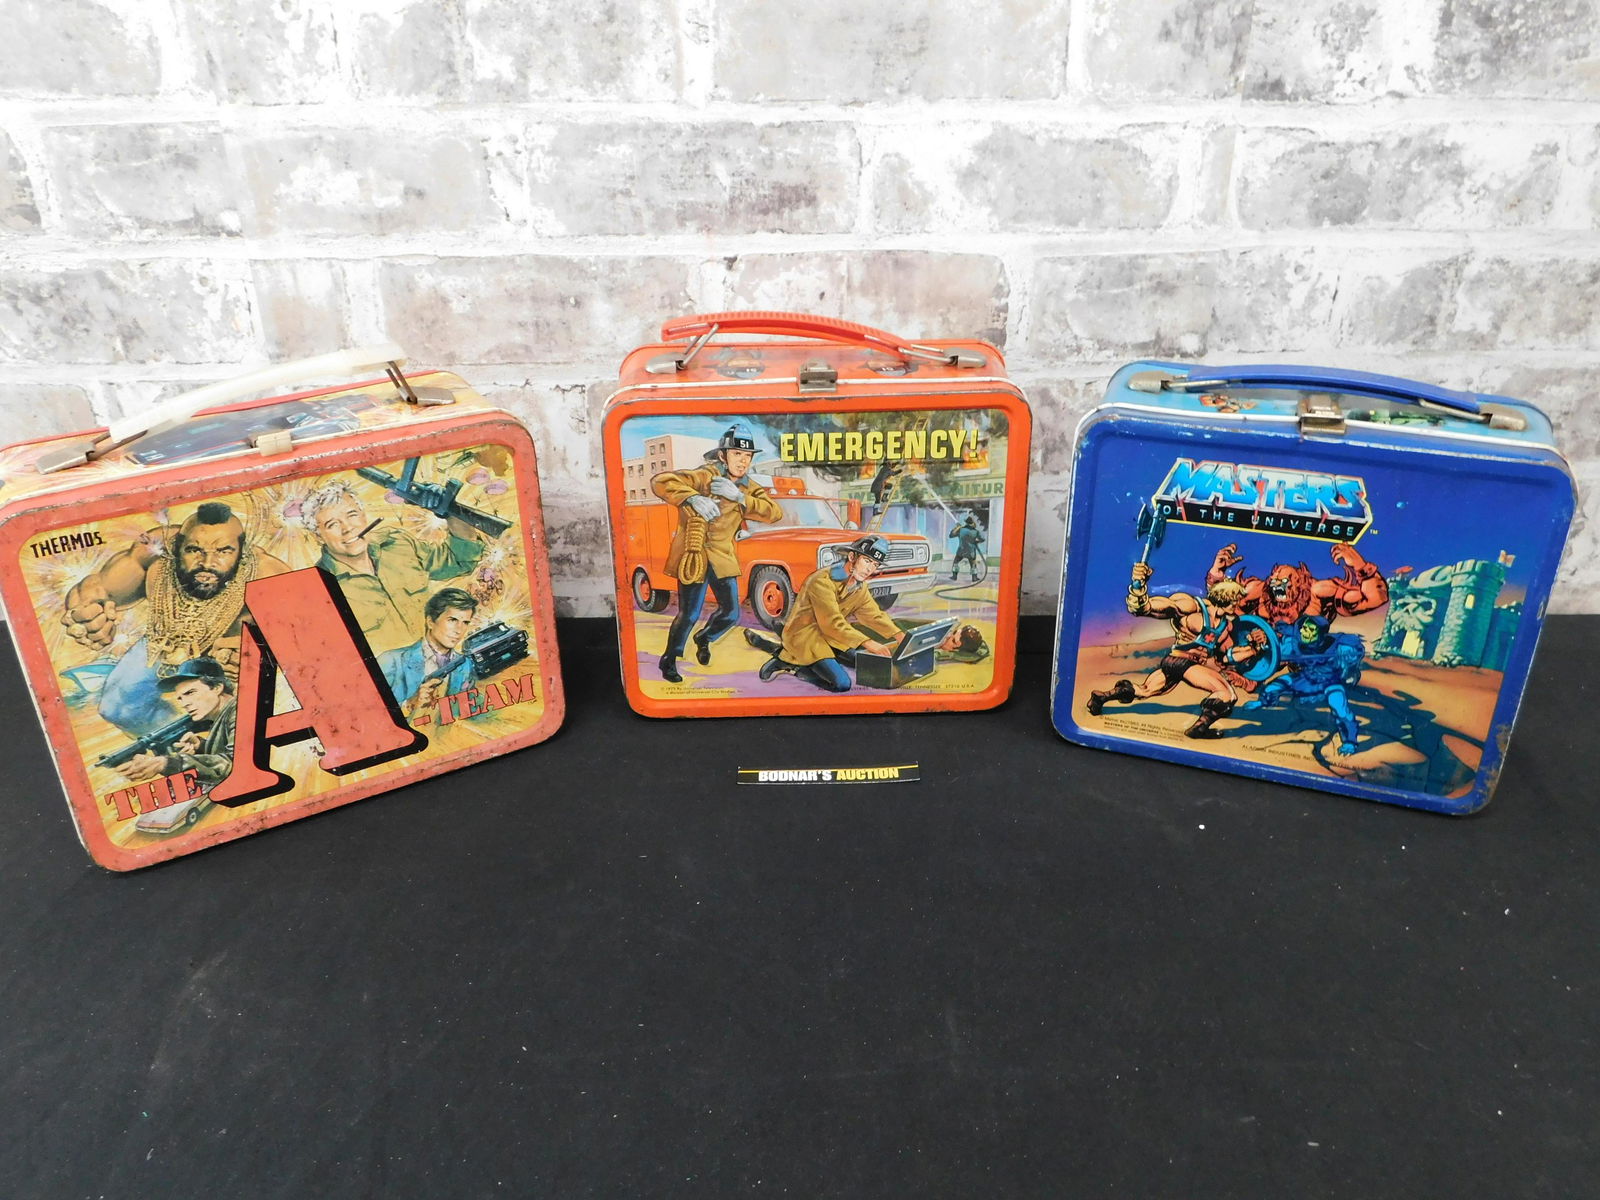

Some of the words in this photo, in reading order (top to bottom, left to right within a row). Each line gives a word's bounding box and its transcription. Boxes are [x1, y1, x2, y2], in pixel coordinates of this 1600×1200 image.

[739, 440, 749, 449] 51
[780, 429, 979, 462] EMERGENCY!
[1156, 459, 1369, 521] MASTERS
[1163, 504, 1184, 517] OF
[1200, 509, 1235, 523] THE
[1252, 515, 1355, 537] UNIVERSE
[30, 531, 104, 558] THERMOS
[873, 551, 883, 560] 51
[758, 770, 833, 782] BODNAR'S
[836, 767, 899, 781] AUCTION
[104, 767, 204, 822] THE
